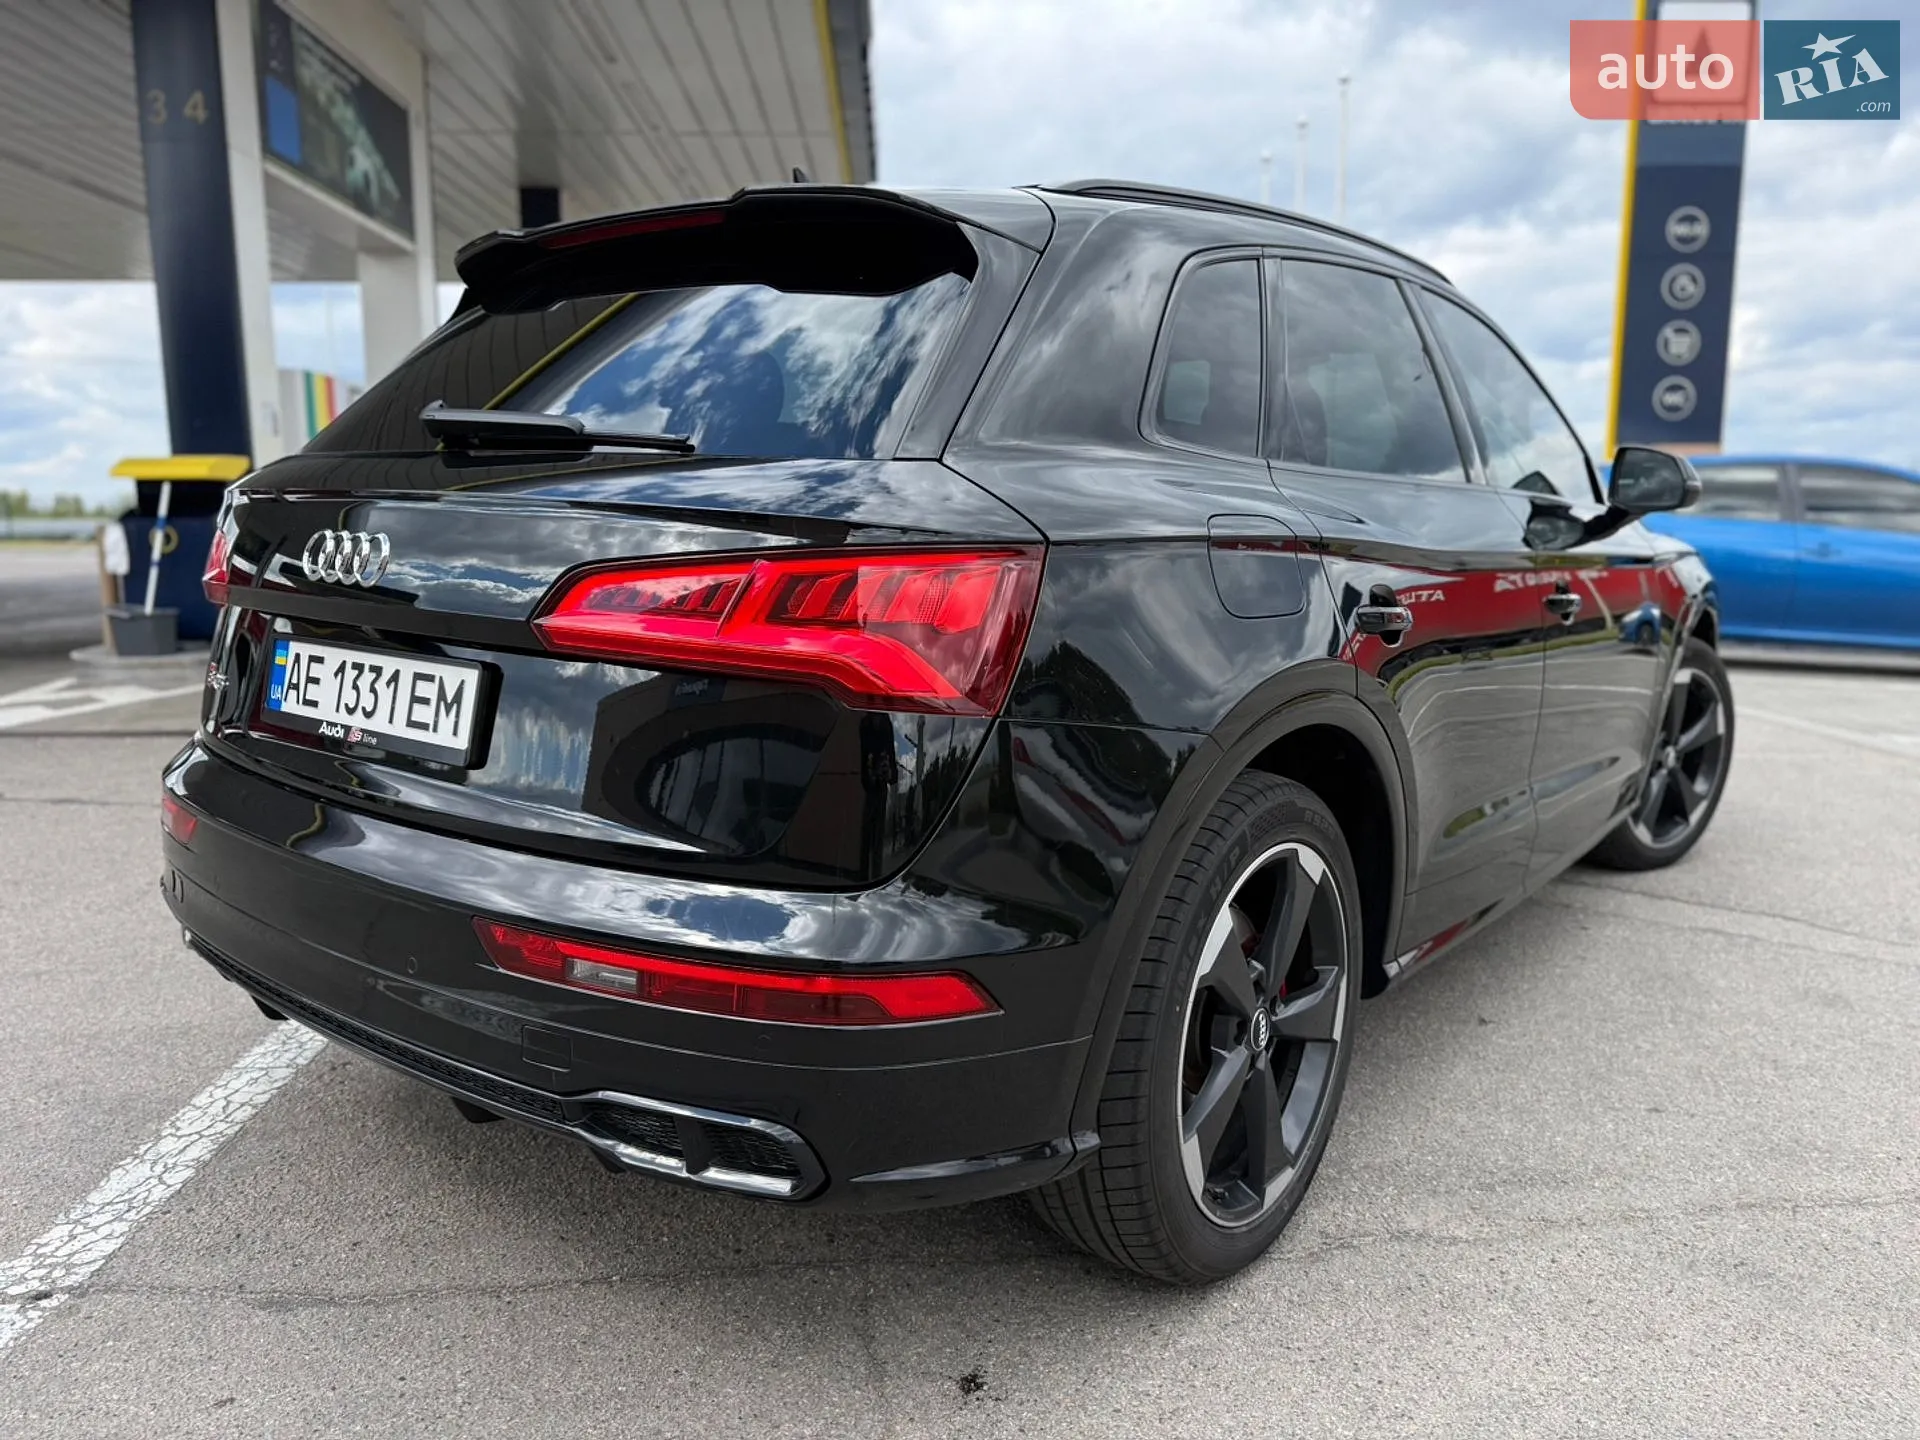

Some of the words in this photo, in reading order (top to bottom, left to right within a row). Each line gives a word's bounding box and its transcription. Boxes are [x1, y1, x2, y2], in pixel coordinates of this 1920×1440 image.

[145, 90, 168, 125] 3
[183, 90, 209, 125] 4
[270, 683, 282, 700] UA
[283, 652, 326, 709] AE
[333, 659, 402, 726] 1331
[405, 671, 466, 738] EM
[318, 721, 345, 739] Audi
